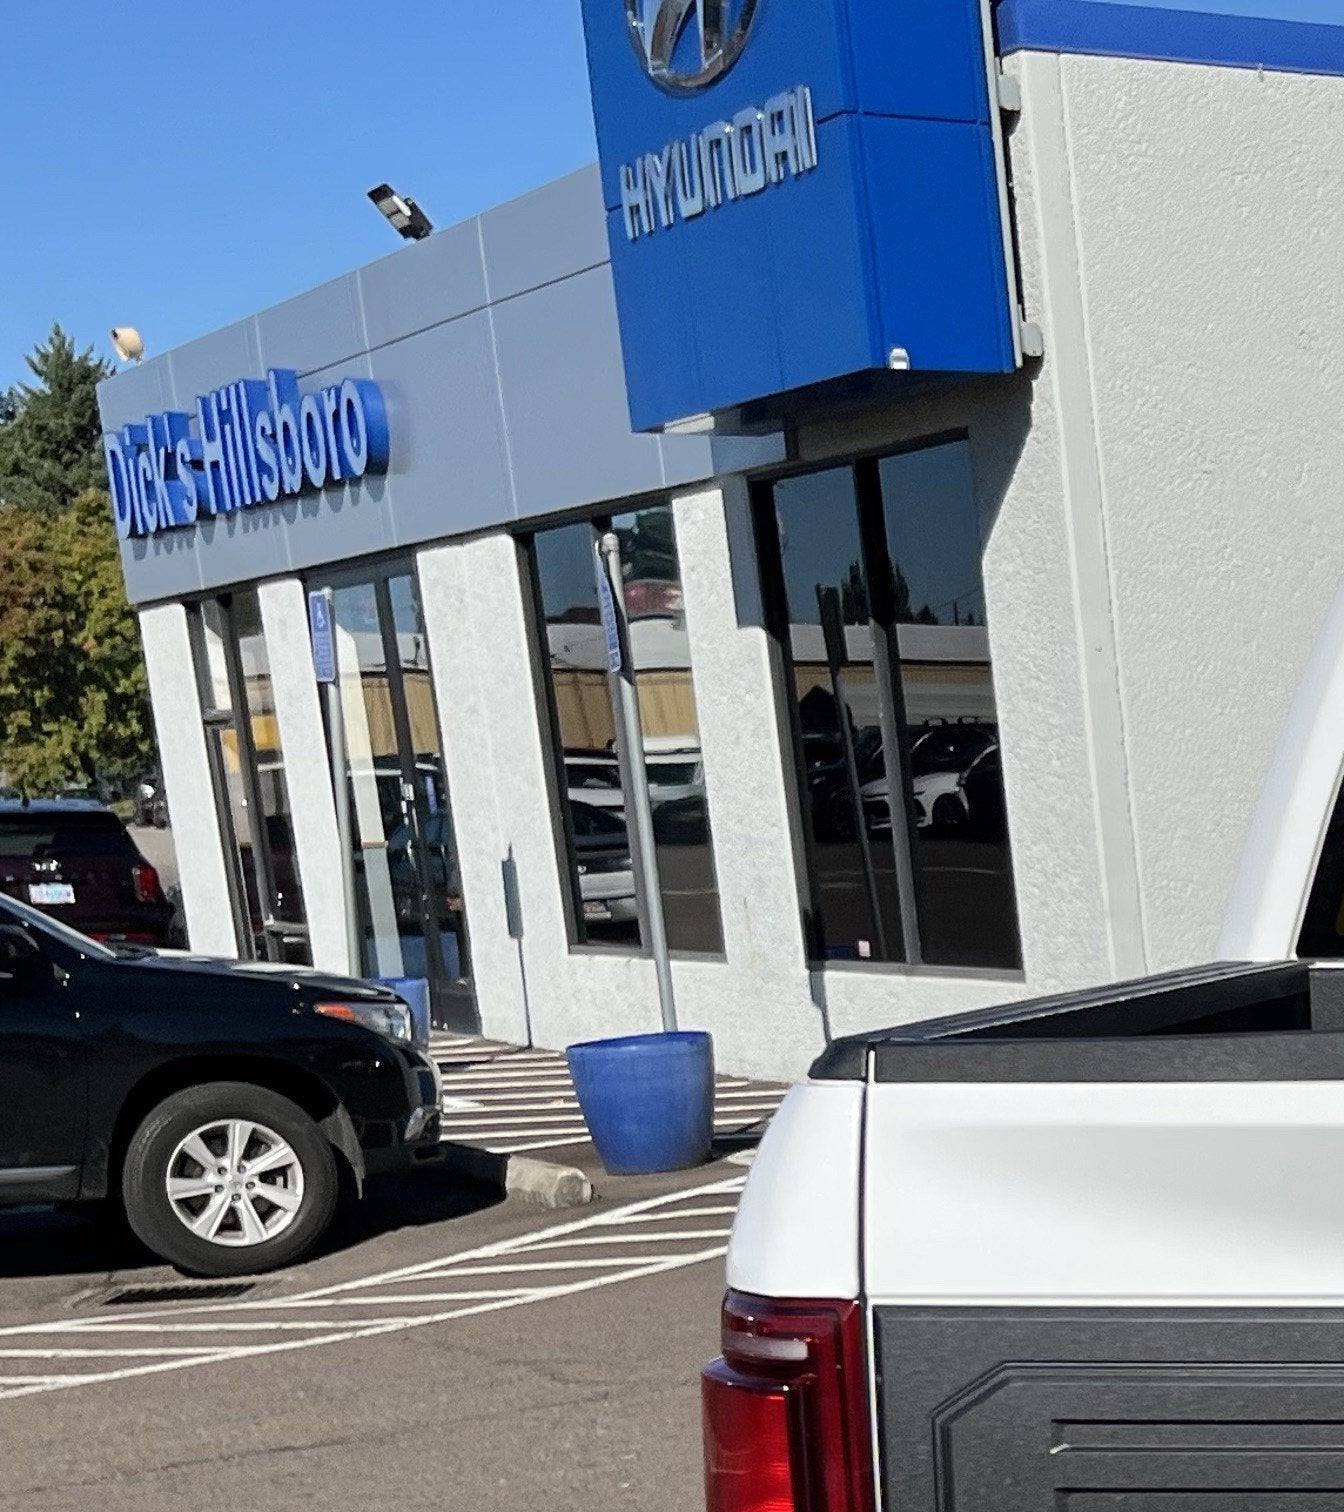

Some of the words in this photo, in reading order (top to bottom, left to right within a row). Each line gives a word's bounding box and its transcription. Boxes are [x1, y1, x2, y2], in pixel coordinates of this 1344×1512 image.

[619, 84, 818, 240] HYUNDAI
[103, 411, 198, 539] Dick's
[197, 369, 374, 514] Hillsboro
